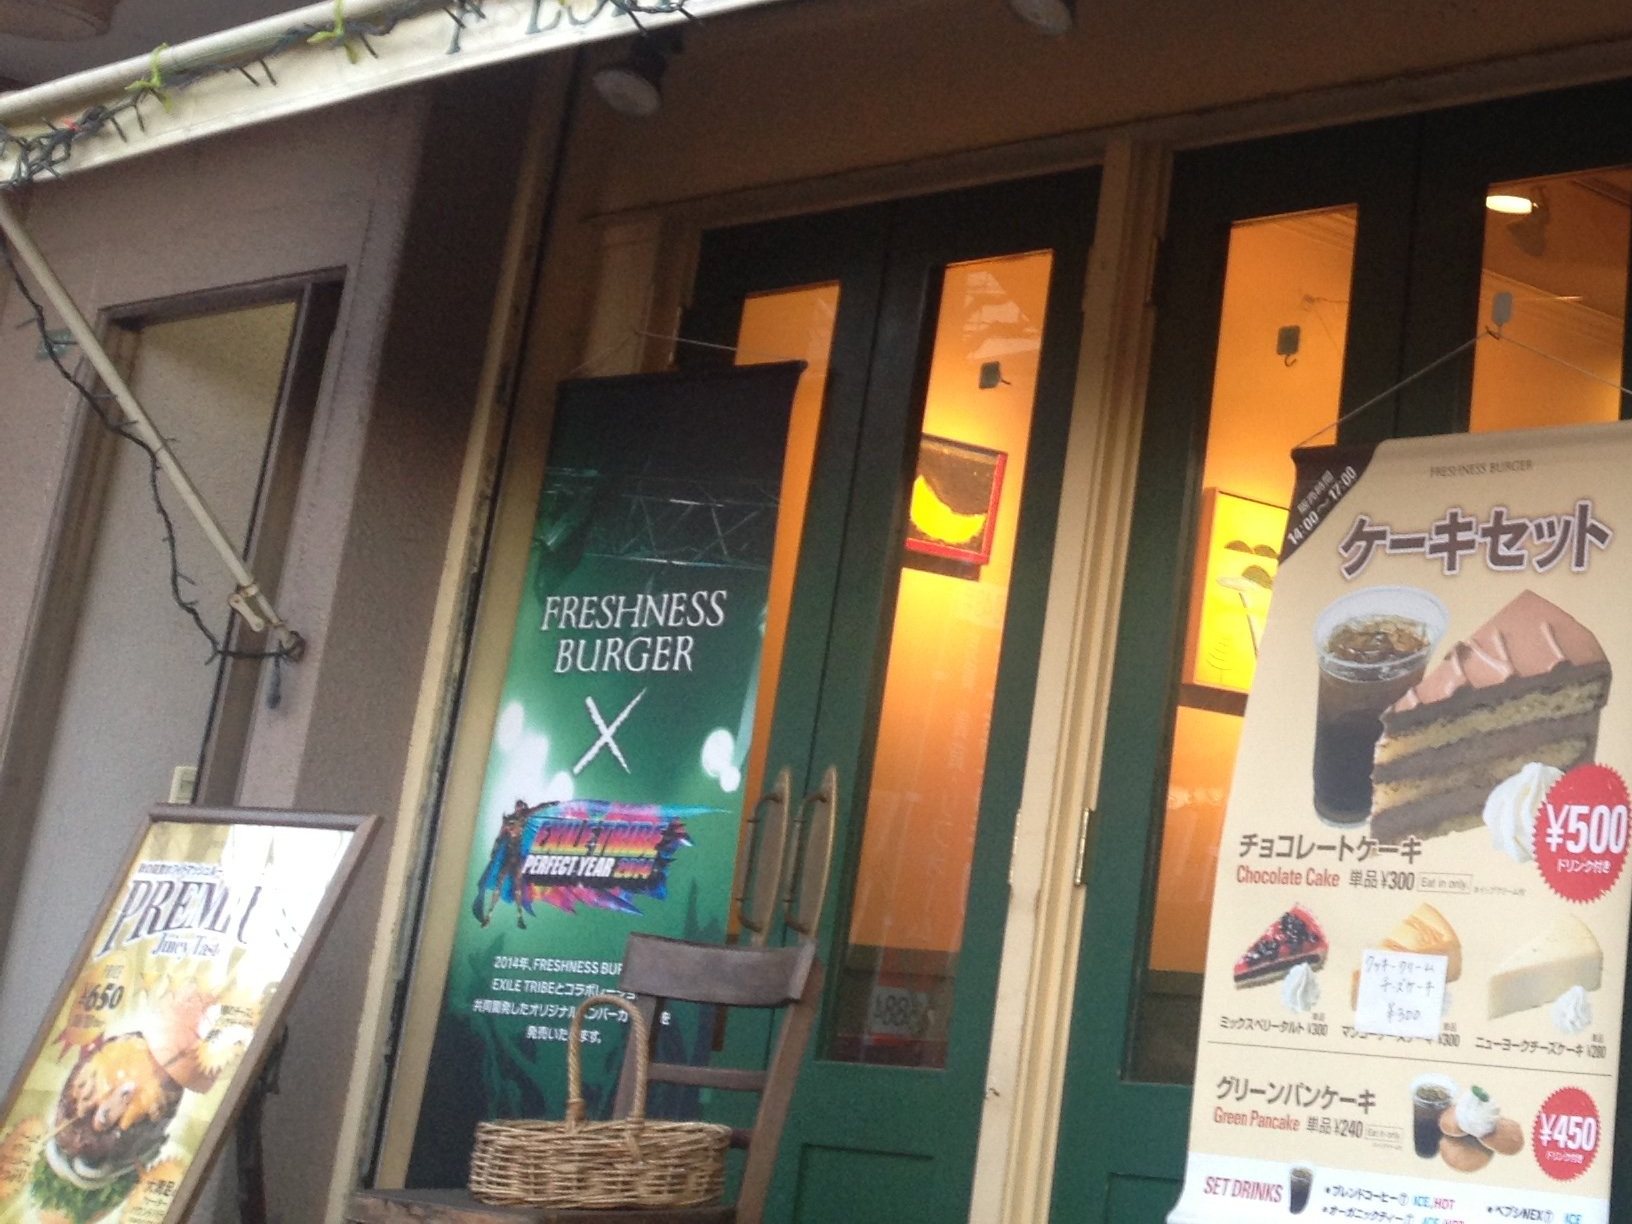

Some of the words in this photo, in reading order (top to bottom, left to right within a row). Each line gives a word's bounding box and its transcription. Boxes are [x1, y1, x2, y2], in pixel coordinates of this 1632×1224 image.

[1430, 463, 1487, 478] FRESHNESS
[1489, 459, 1533, 474] BURGER
[1341, 502, 1611, 578] ケーキセット
[540, 589, 727, 631] FRESHNESS
[554, 635, 694, 673] BURGER
[1545, 804, 1628, 854] ¥500
[1239, 833, 1423, 864] チョコレートケーキ
[522, 854, 580, 876] PERFECT
[577, 857, 616, 877] YEAR
[1236, 864, 1303, 886] Chocolate
[1305, 867, 1340, 887] Cake
[1349, 869, 1379, 890] 単品
[1381, 871, 1416, 891] ¥300
[492, 978, 521, 992] EXILE
[1220, 1015, 1304, 1036] ミックスベリータルト
[1475, 1036, 1584, 1058] ニューヨークチーズケーキ
[1213, 1105, 1248, 1126] Green
[1250, 1109, 1301, 1132] Pancake
[1306, 1115, 1332, 1135] 単品
[1334, 1119, 1364, 1139] ¥240
[1538, 1113, 1597, 1152] ¥450
[1203, 1176, 1231, 1196] SET
[1231, 1179, 1284, 1203] DRINKS
